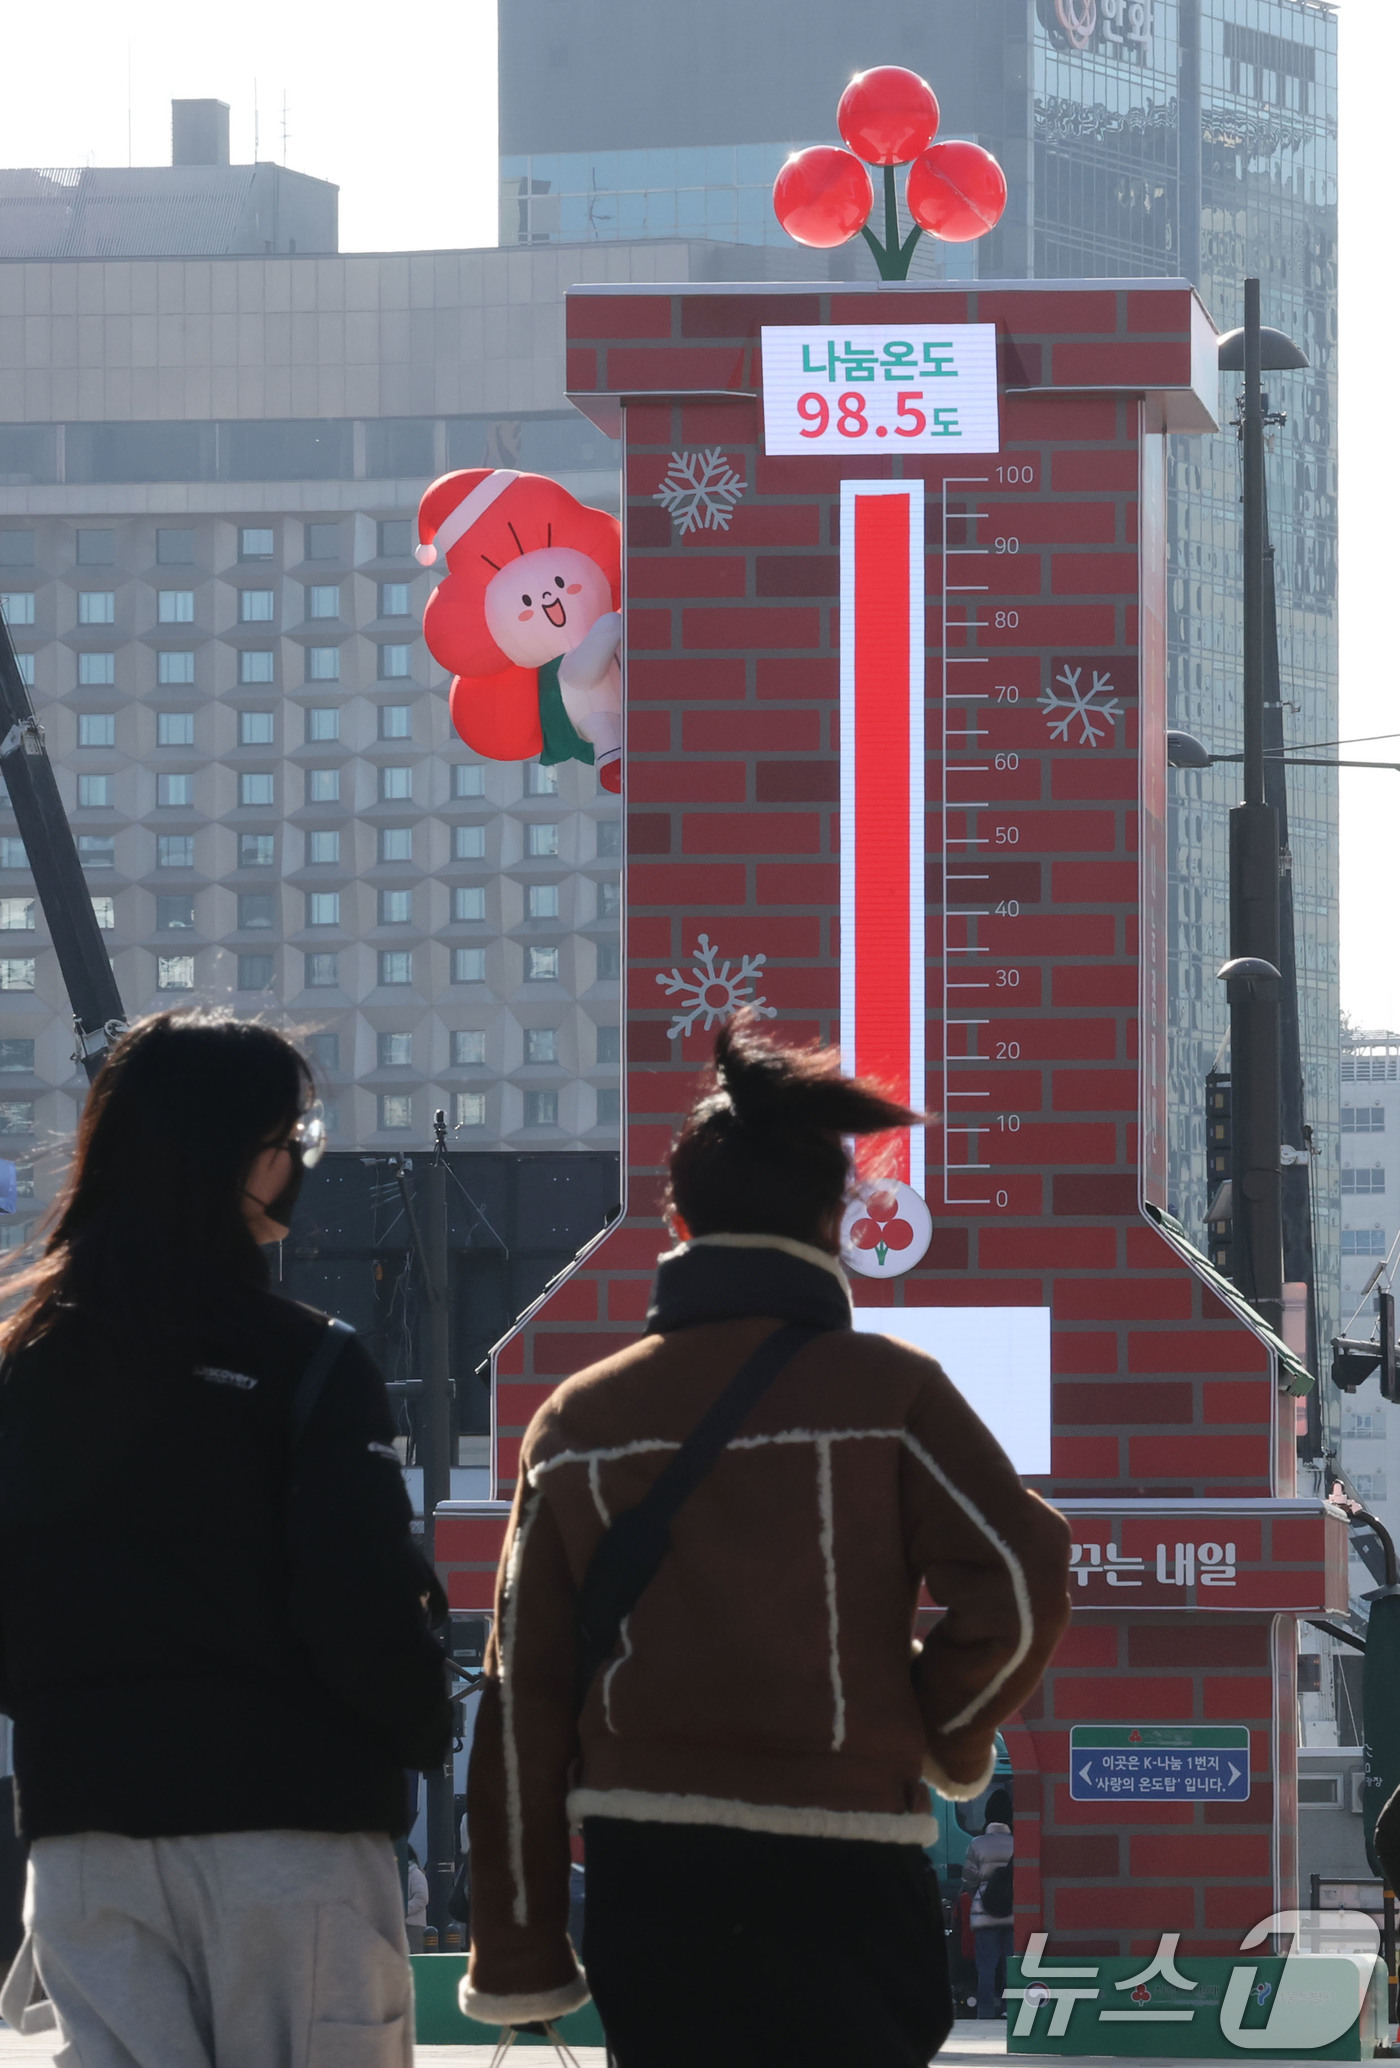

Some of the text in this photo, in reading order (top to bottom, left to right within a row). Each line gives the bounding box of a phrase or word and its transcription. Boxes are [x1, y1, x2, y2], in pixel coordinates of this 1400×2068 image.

[802, 340, 959, 382] 나눔온도
[797, 391, 962, 438] 98.5도
[995, 465, 1034, 483] 100
[994, 537, 1020, 554] 90
[994, 611, 1019, 628] 80
[994, 686, 1019, 703] 70
[994, 753, 1019, 770] 60
[995, 826, 1019, 844] 50
[994, 900, 1020, 917] 40
[995, 969, 1020, 987] 30
[995, 1041, 1020, 1060] 20
[996, 1114, 1020, 1132] 10
[996, 1190, 1008, 1207] 0
[1156, 1543, 1236, 1586] 내일
[1102, 1756, 1140, 1770] 이곳은
[1143, 1756, 1183, 1771] K-나눔
[1184, 1777, 1226, 1792] 입니다.
